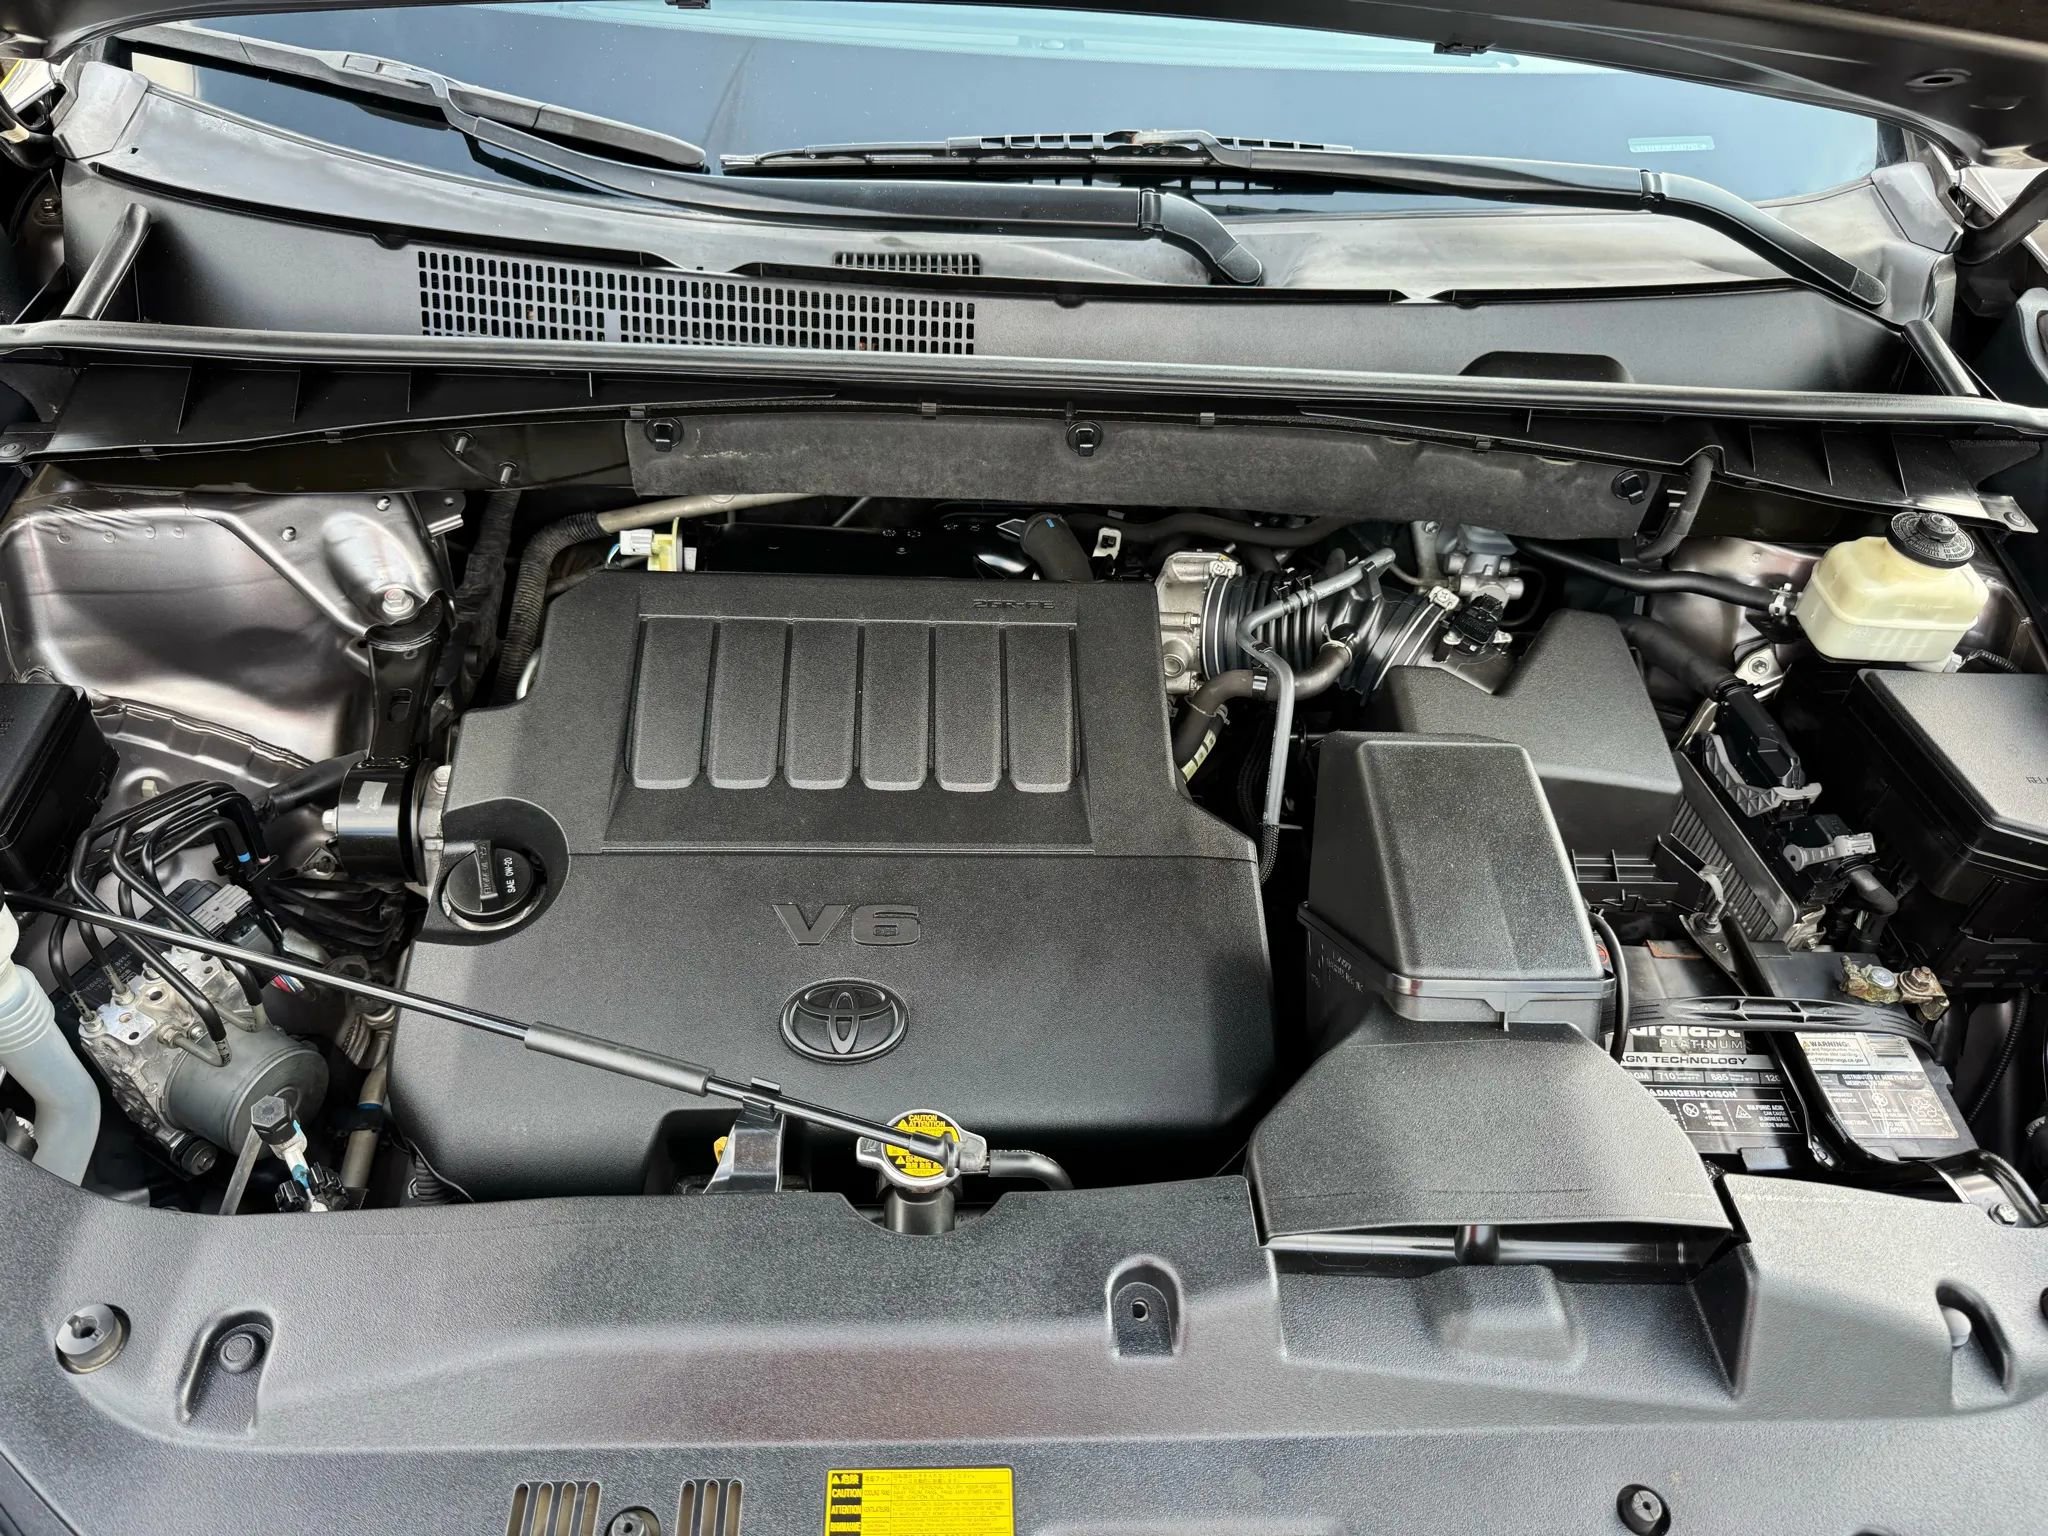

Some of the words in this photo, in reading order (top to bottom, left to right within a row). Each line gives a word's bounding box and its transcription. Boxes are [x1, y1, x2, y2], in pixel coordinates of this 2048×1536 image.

[504, 857, 514, 877] 0W-20
[506, 879, 516, 893] SAE
[772, 903, 921, 947] V6
[1659, 1038, 1744, 1049] PLATINUM
[1652, 1056, 1748, 1065] TECHNOLOGY
[1657, 1072, 1676, 1080] 710
[1656, 1088, 1737, 1098] DANGER/POISON
[908, 1120, 946, 1128] ATTENTION
[832, 1488, 862, 1498] CAUTION
[831, 1504, 862, 1515] ATTENTION
